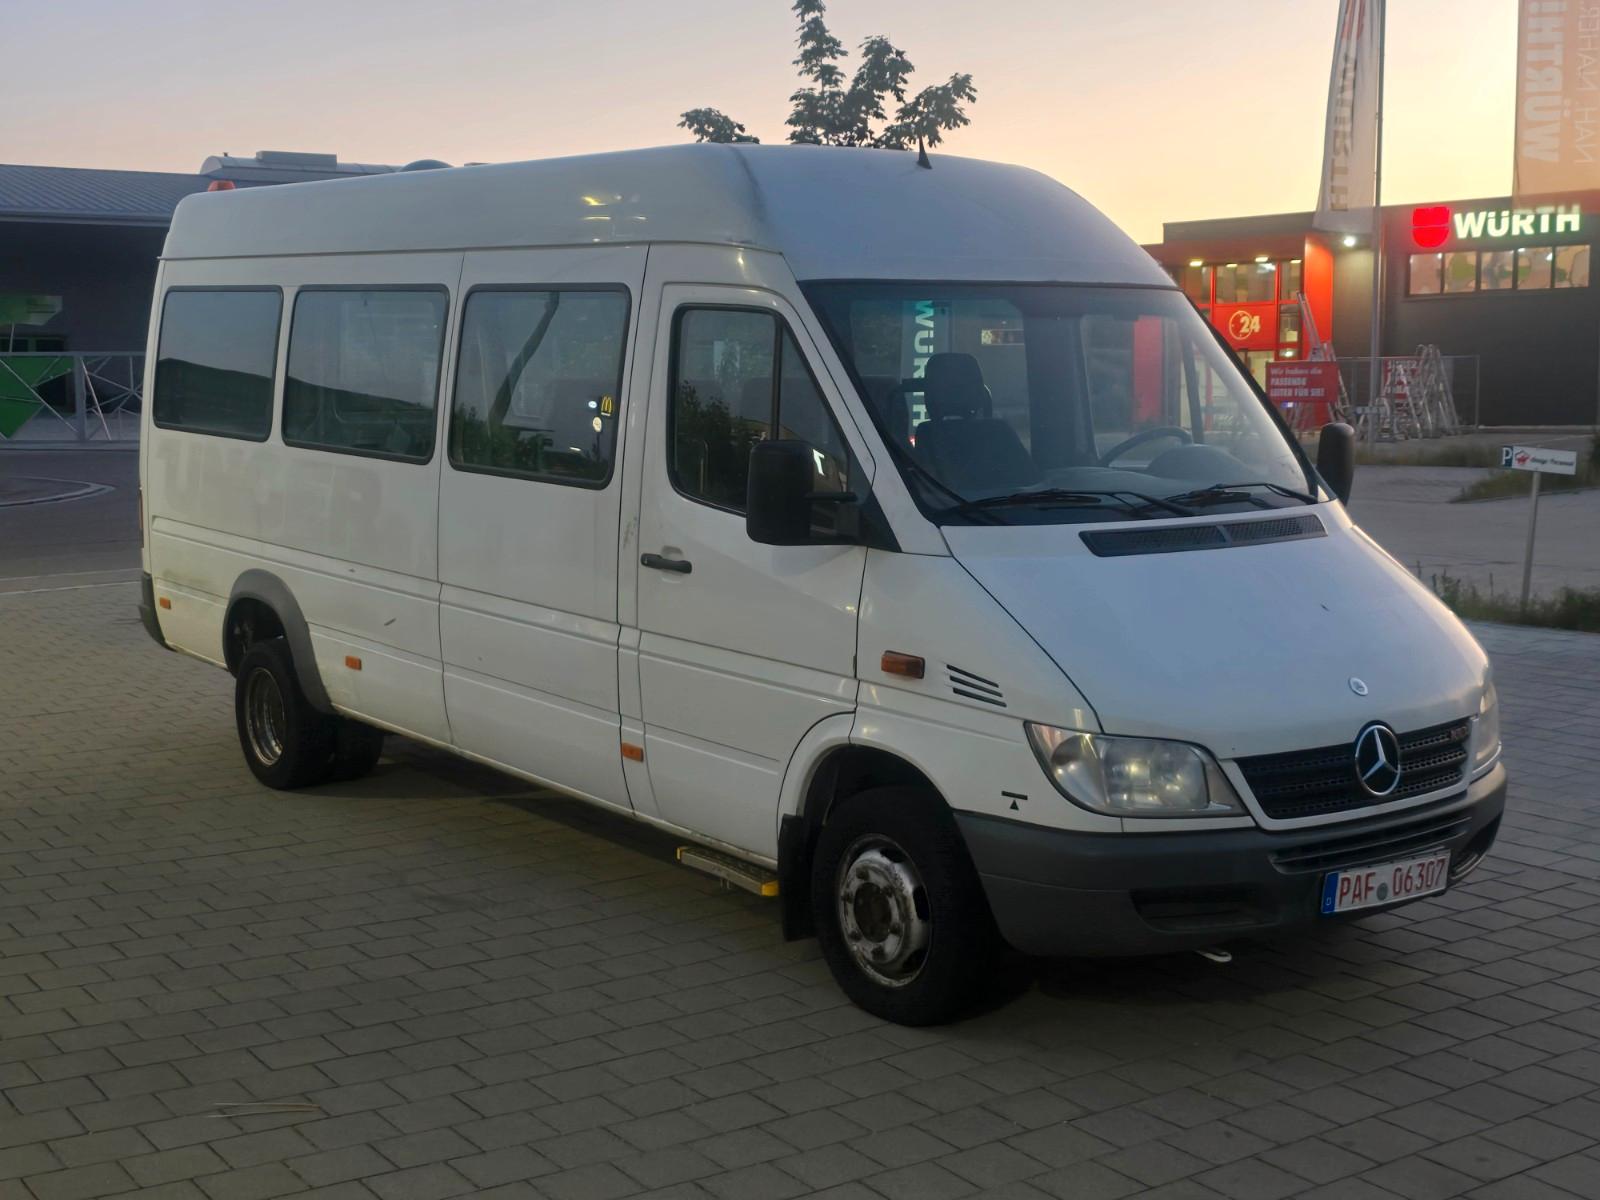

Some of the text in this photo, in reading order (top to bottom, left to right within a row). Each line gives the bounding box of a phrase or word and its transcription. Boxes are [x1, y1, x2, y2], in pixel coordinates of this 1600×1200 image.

[1453, 204, 1581, 239] WÜRTH
[1240, 315, 1261, 333] 24
[1502, 447, 1512, 465] P
[1338, 871, 1376, 908] PAF
[1392, 858, 1446, 897] 06307
